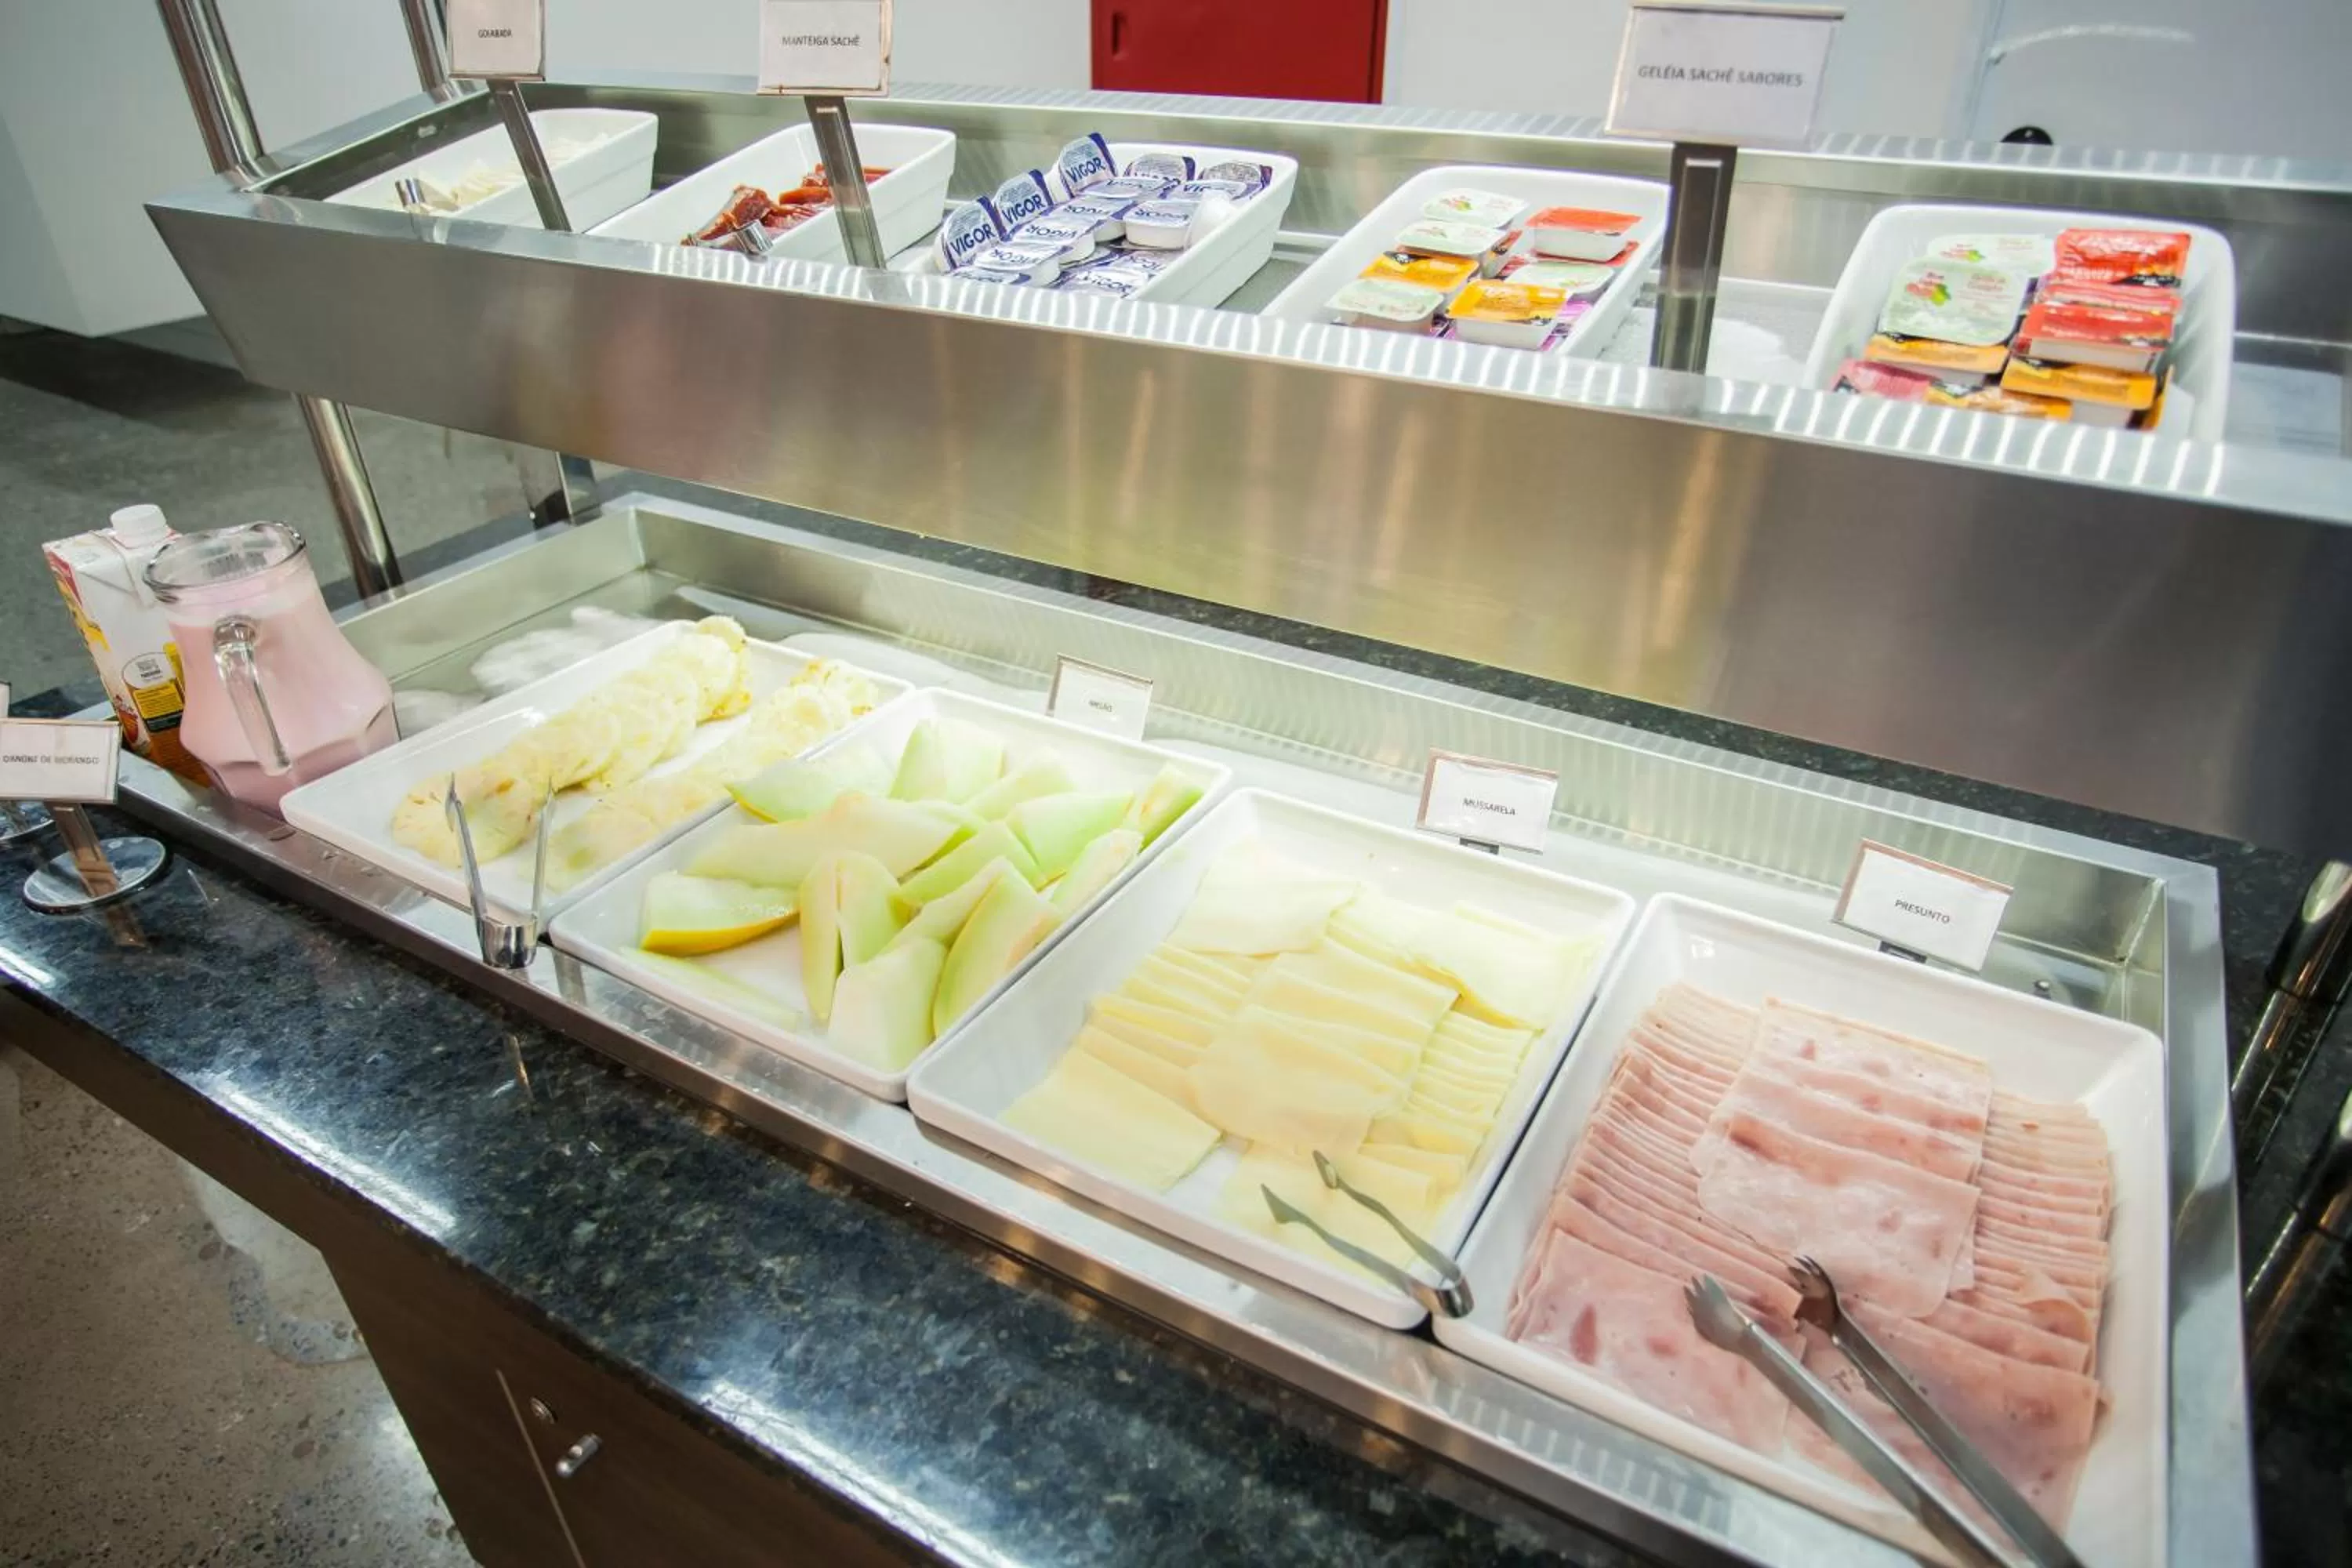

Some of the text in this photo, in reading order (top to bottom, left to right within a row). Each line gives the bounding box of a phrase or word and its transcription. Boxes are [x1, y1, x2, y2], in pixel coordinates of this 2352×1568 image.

[782, 36, 829, 46] MANTEIGA
[1065, 156, 1106, 183] VIGOR
[1002, 194, 1046, 225] VIGOR
[949, 223, 996, 257] VIGOR
[1463, 797, 1515, 816] MUSSARELA
[1894, 899, 1951, 924] PRESUNTO
